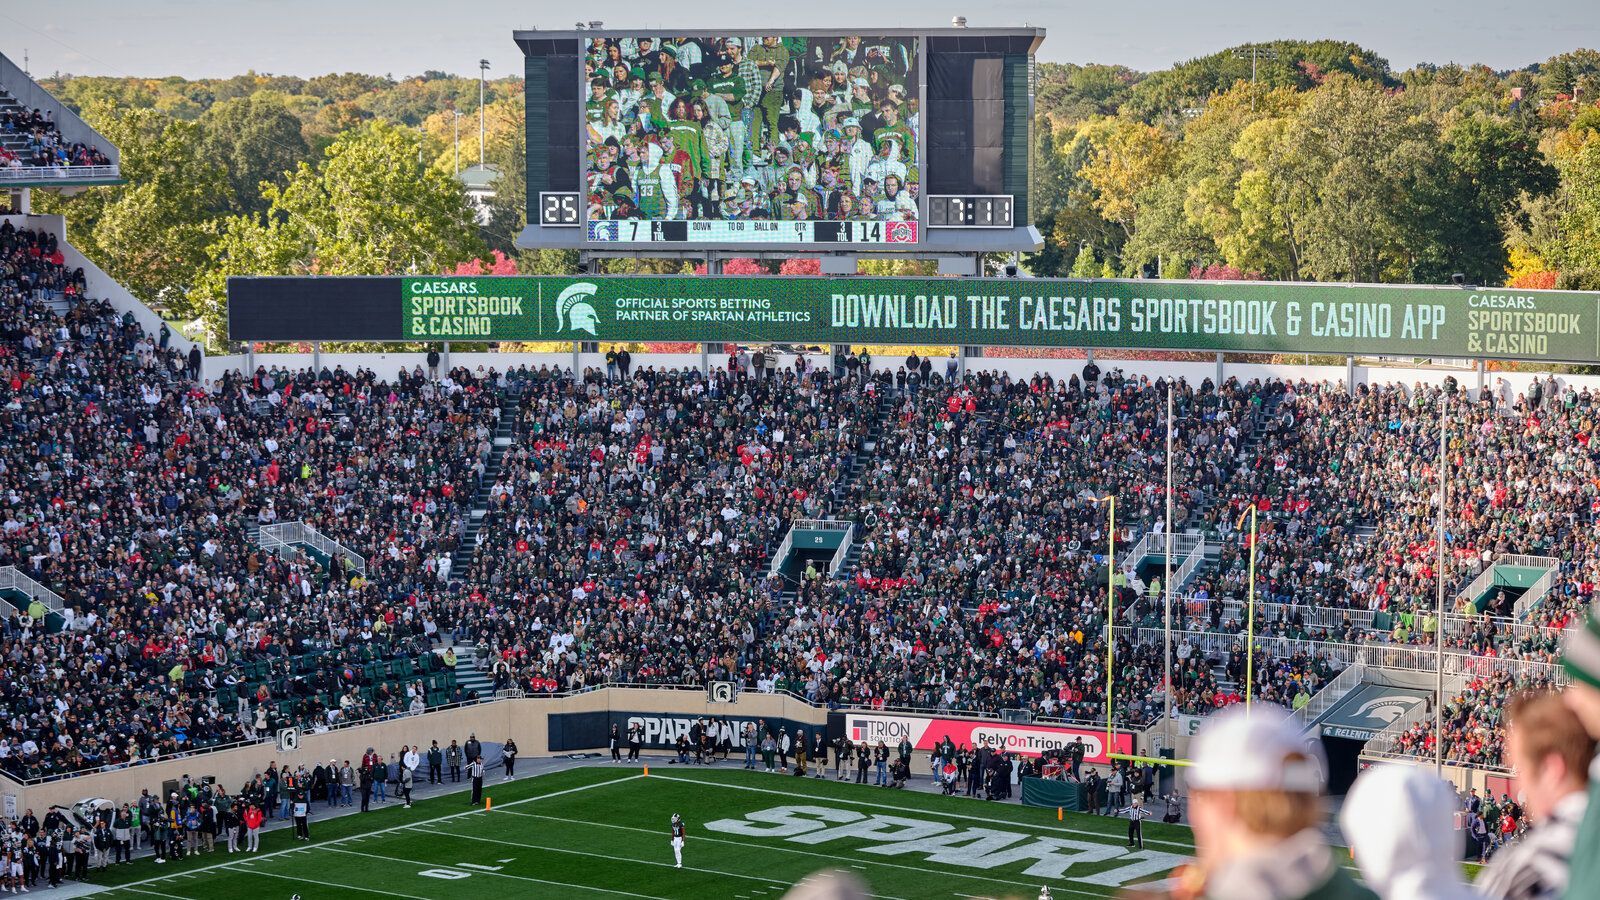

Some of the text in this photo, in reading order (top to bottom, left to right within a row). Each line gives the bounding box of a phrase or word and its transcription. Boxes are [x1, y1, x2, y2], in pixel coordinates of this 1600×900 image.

[545, 196, 577, 221] 25
[952, 198, 1010, 222] 7:11
[629, 222, 639, 241] 7
[656, 222, 662, 231] 3
[692, 222, 711, 231] DOWN
[728, 222, 745, 231] TO GO
[754, 222, 779, 231] BALL ON
[794, 222, 807, 232] QTR
[839, 222, 846, 232] 3
[860, 222, 881, 242] 14
[798, 232, 803, 242] 1
[411, 281, 474, 294] CAESARS
[411, 296, 523, 316] SPORTSBOOK
[615, 298, 771, 310] OFFICIAL SPORTS BETTING
[1468, 294, 1536, 310] CAESARS
[615, 309, 811, 322] PARTNER OF SPARTAN ATHLETICS
[831, 293, 1446, 340] DOWNLOAD THE CAESARS SPORTSBOOK & CASINO APP
[1468, 310, 1581, 336] SPORTSBOOK
[411, 316, 491, 336] & CASINO
[1468, 332, 1548, 355] & CASINO
[868, 720, 910, 737] TRION
